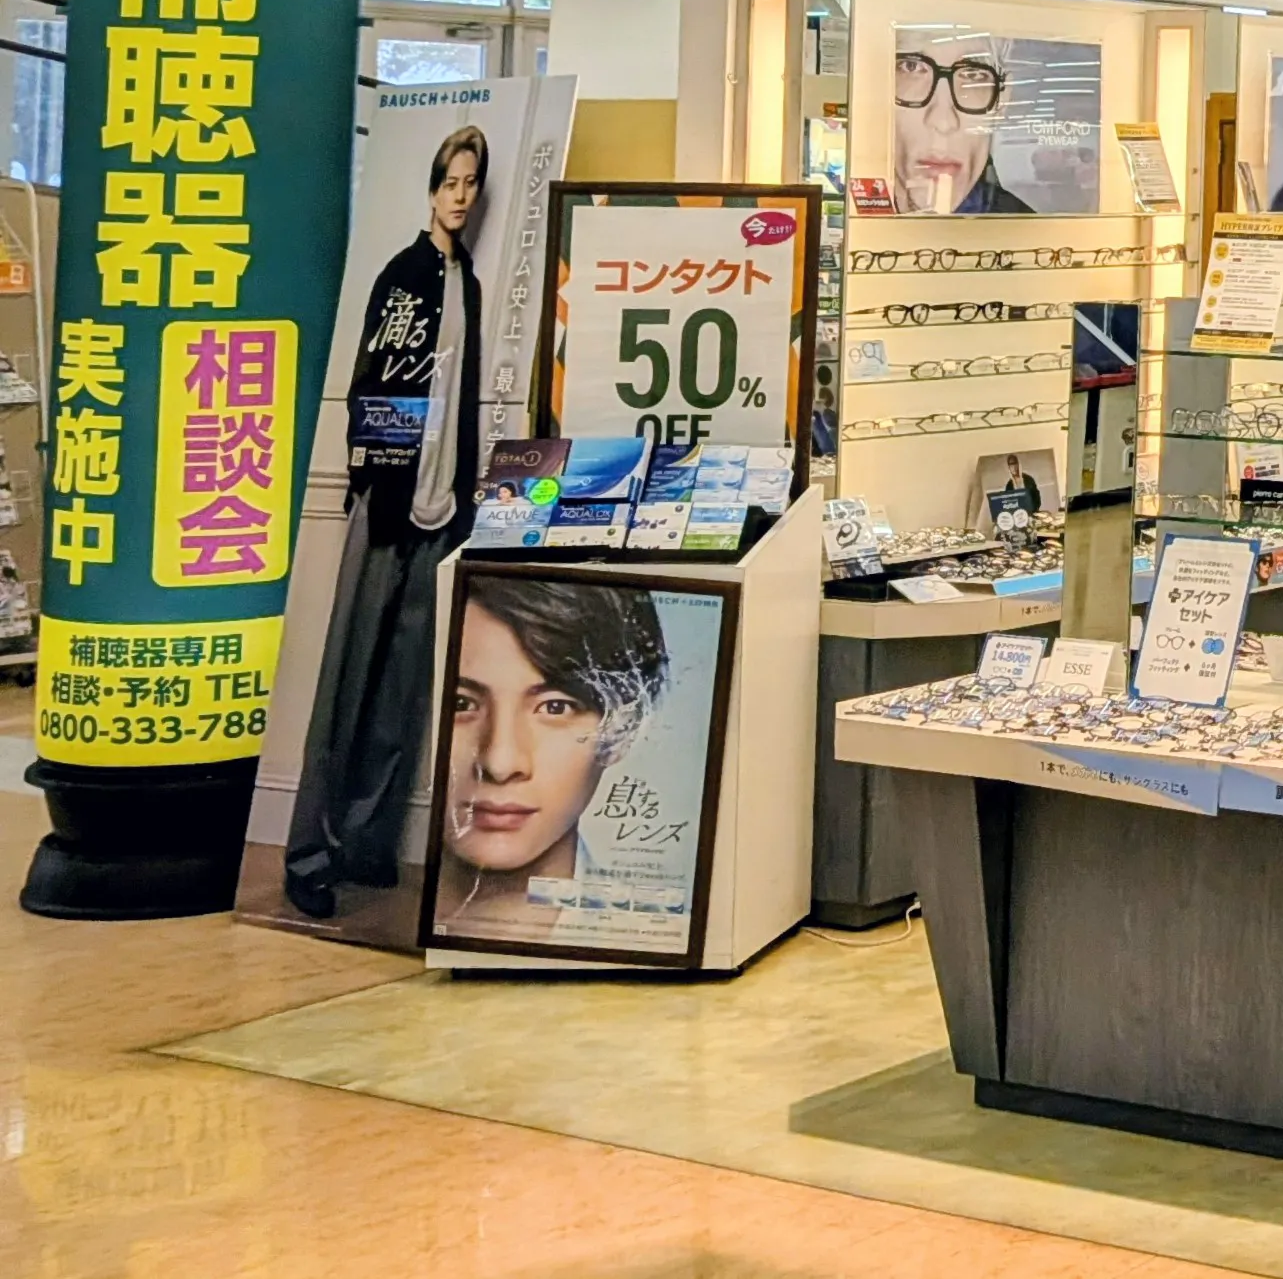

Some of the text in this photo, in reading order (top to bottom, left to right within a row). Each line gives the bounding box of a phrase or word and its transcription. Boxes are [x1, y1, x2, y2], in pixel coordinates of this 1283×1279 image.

[594, 258, 773, 295] コンタクト
[381, 345, 454, 383] レンズ
[615, 308, 767, 409] 50%
[52, 319, 125, 586] 実施中
[177, 330, 277, 577] 相談会
[1183, 589, 1231, 606] アイケア
[1179, 608, 1212, 624] セット
[69, 633, 243, 668] 補聴器専用
[1063, 662, 1092, 676] ESSE
[51, 670, 270, 708] 相談・予約 TEL
[40, 708, 267, 744] 0800-333-788
[616, 820, 689, 844] レンズ
